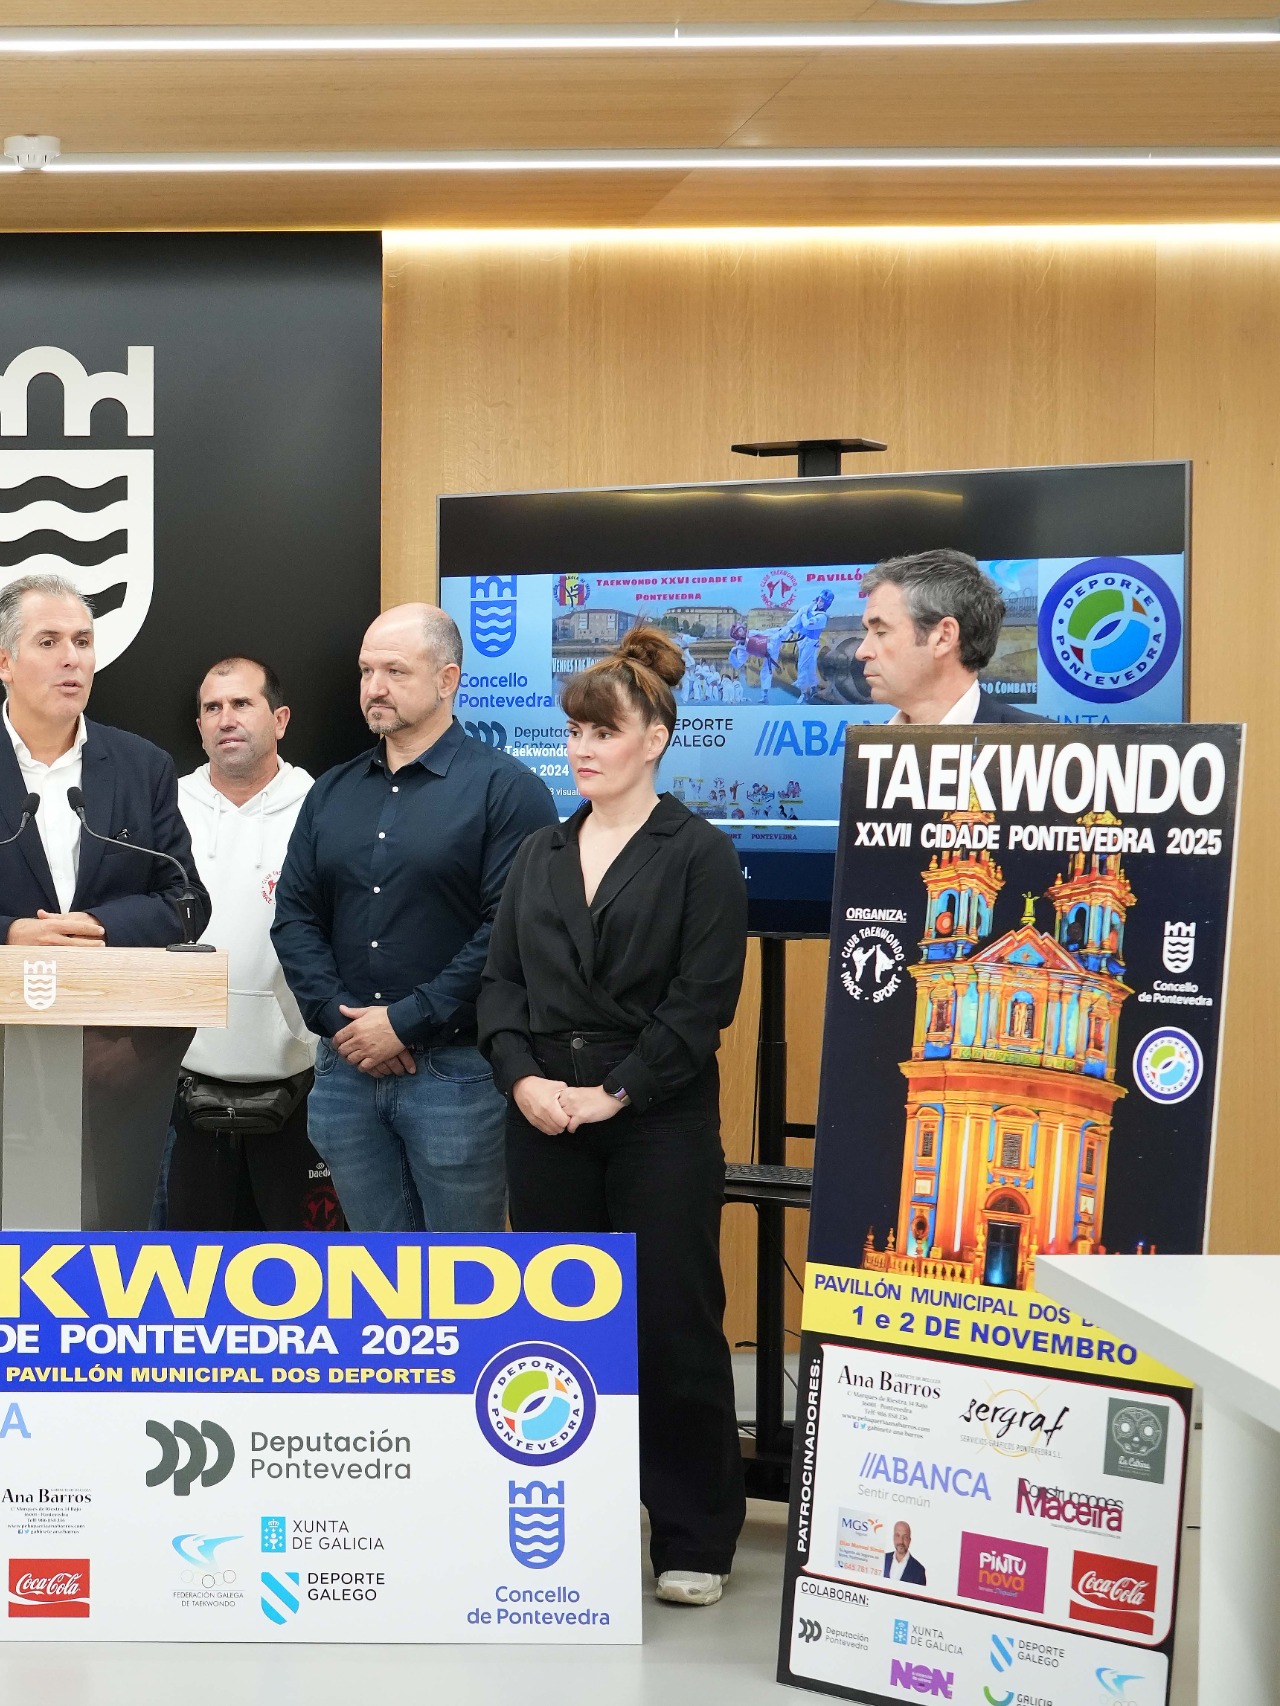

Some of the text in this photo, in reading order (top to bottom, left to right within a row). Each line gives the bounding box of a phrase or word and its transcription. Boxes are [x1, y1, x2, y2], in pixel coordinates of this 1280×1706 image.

[806, 568, 864, 582] PAVILLÓ
[635, 593, 702, 601] PONTEVEDRA
[1063, 577, 1155, 609] DEPORTE
[1056, 632, 1163, 685] PONTEVEDRA
[460, 672, 528, 688] Concello
[995, 681, 1037, 694] COMBATE
[459, 692, 553, 708] Pontevedra
[514, 727, 570, 741] Deputac
[673, 718, 734, 732] EPORTE
[669, 735, 726, 748] ALEGO
[540, 765, 570, 776] 2024
[857, 741, 1226, 816] TAEKWONDO
[854, 821, 1223, 856] XXVII CIDADE PONTEVEDRA 2025
[845, 907, 907, 922] ORGANIZA:
[841, 926, 905, 961] CLUB TAEKWONDO
[840, 971, 902, 1003] MACE SPORT
[1153, 979, 1199, 993] Concello
[1137, 991, 1213, 1007] de Pontevedra
[814, 1273, 902, 1301] PAVILLÓN
[910, 1287, 1019, 1317] MUNICIPAL
[1028, 1302, 1071, 1325] DOS
[60, 1323, 340, 1355] PONTEVEDRA
[361, 1324, 460, 1356] 2025
[852, 1305, 864, 1326] 1
[875, 1312, 890, 1329] e
[899, 1312, 915, 1334] 2
[924, 1316, 961, 1341] DE
[970, 1321, 1138, 1366] NOVEMBRO
[6, 1363, 123, 1383] PAVILLÓN
[131, 1366, 264, 1384] MUNICIPAL
[271, 1366, 321, 1384] DOS
[328, 1367, 456, 1385] DEPORTES
[497, 1360, 574, 1386] DEPORTE
[837, 1364, 941, 1400] Ana Barros
[491, 1407, 580, 1451] PONTEVEDRA
[959, 1398, 1070, 1447] sergraf
[250, 1429, 411, 1459] Deputación
[797, 1358, 821, 1553] PATROCINADORES:
[250, 1458, 411, 1480] Pontevedra
[1, 1488, 92, 1503] Ana Barros
[858, 1483, 931, 1508] Sentir común
[1015, 1477, 1124, 1533] Maceira
[293, 1520, 350, 1533] XUNTA
[841, 1517, 869, 1532] MGS
[293, 1536, 385, 1551] DE GALICIA
[307, 1572, 385, 1585] DEPORTE
[978, 1568, 1025, 1592] nova
[173, 1590, 244, 1599] FEDERACIÓN GALEGA
[307, 1588, 377, 1601] GALEGO
[495, 1585, 580, 1603] Concello
[801, 1581, 869, 1606] COLABORAN:
[467, 1608, 611, 1626] de Pontevedra
[826, 1625, 869, 1643] Deputación
[911, 1624, 944, 1640] XUNTA
[825, 1634, 869, 1651] Pontevedra
[910, 1635, 964, 1655] DE GALICIA
[1018, 1639, 1066, 1658] DEPORTE
[1017, 1651, 1060, 1668] GALEGO
